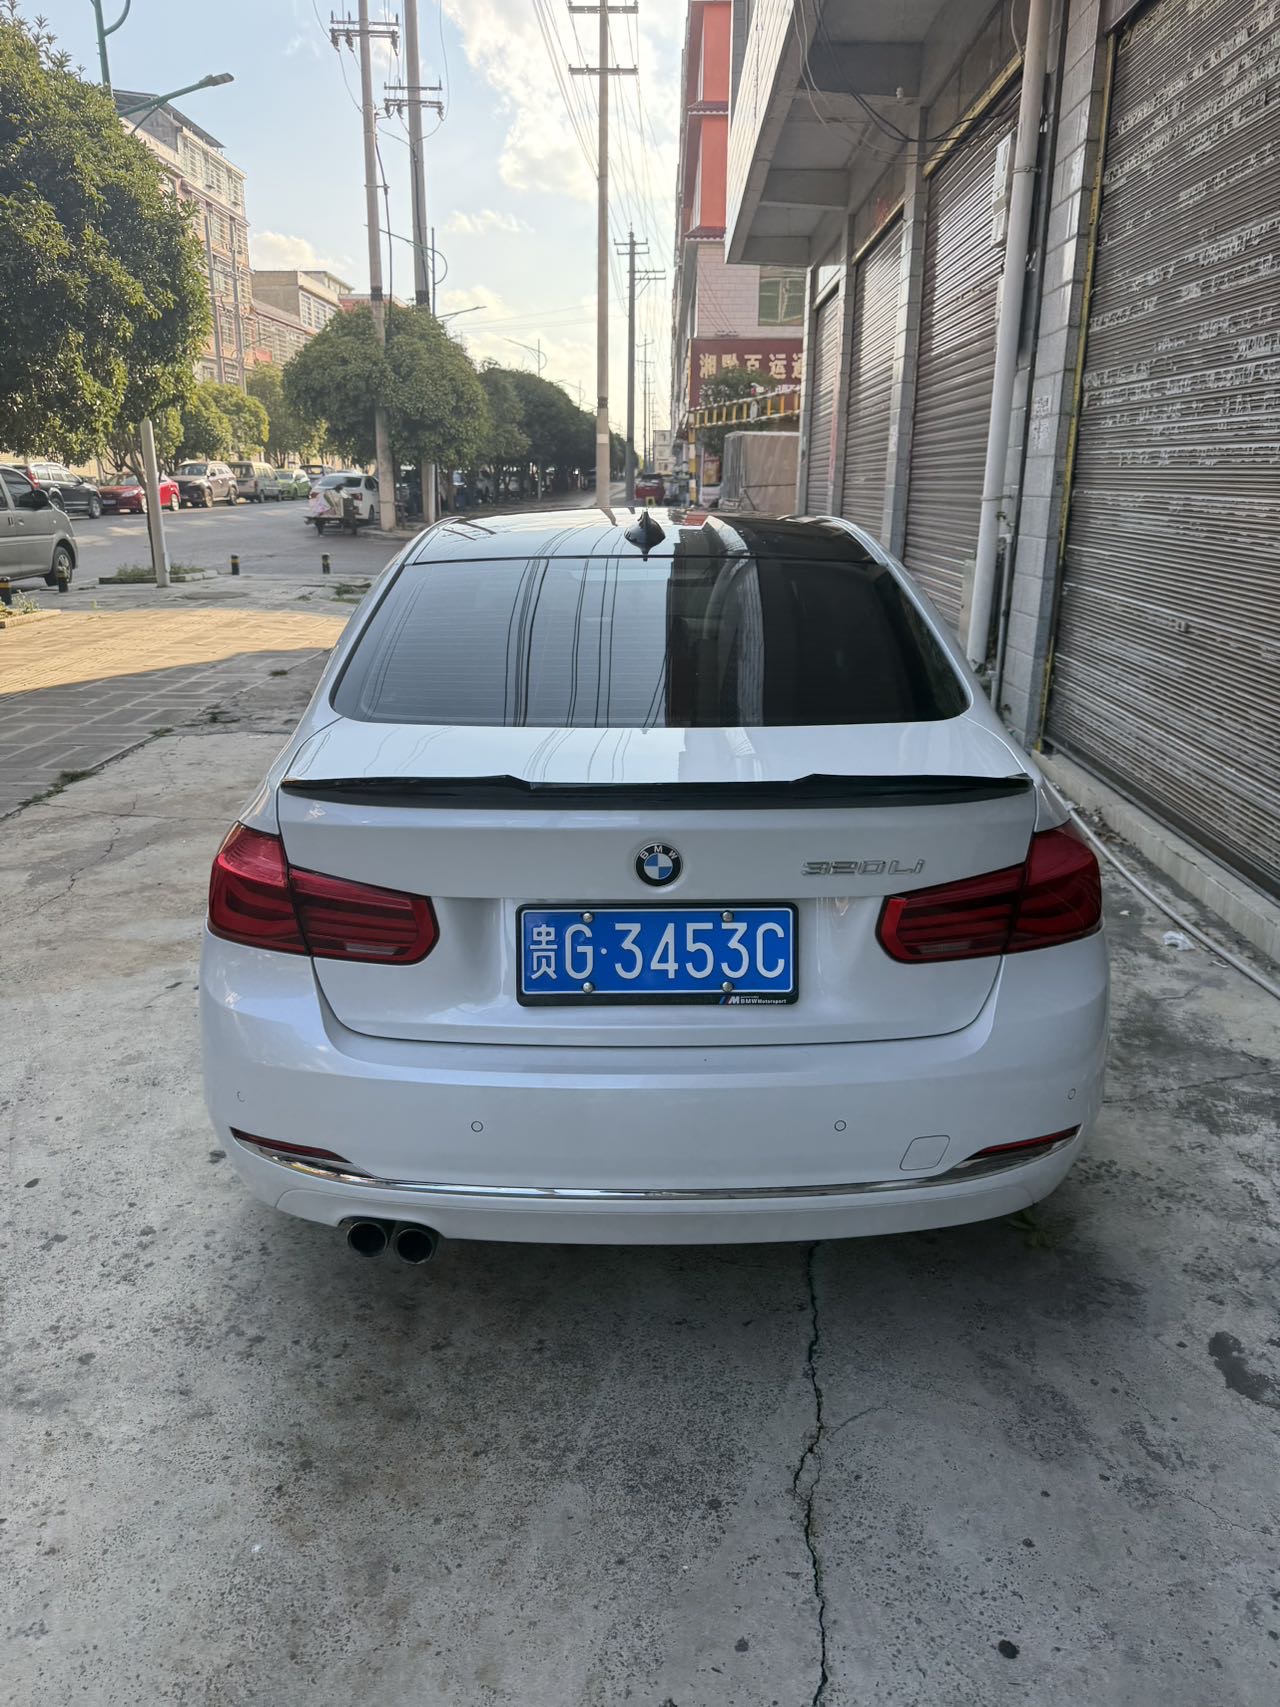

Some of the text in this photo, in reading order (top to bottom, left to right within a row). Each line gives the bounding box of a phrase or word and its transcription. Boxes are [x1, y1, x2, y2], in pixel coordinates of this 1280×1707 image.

[639, 845, 678, 860] BMW
[800, 859, 926, 876] 320Li
[529, 922, 785, 980] 贵G·3453C
